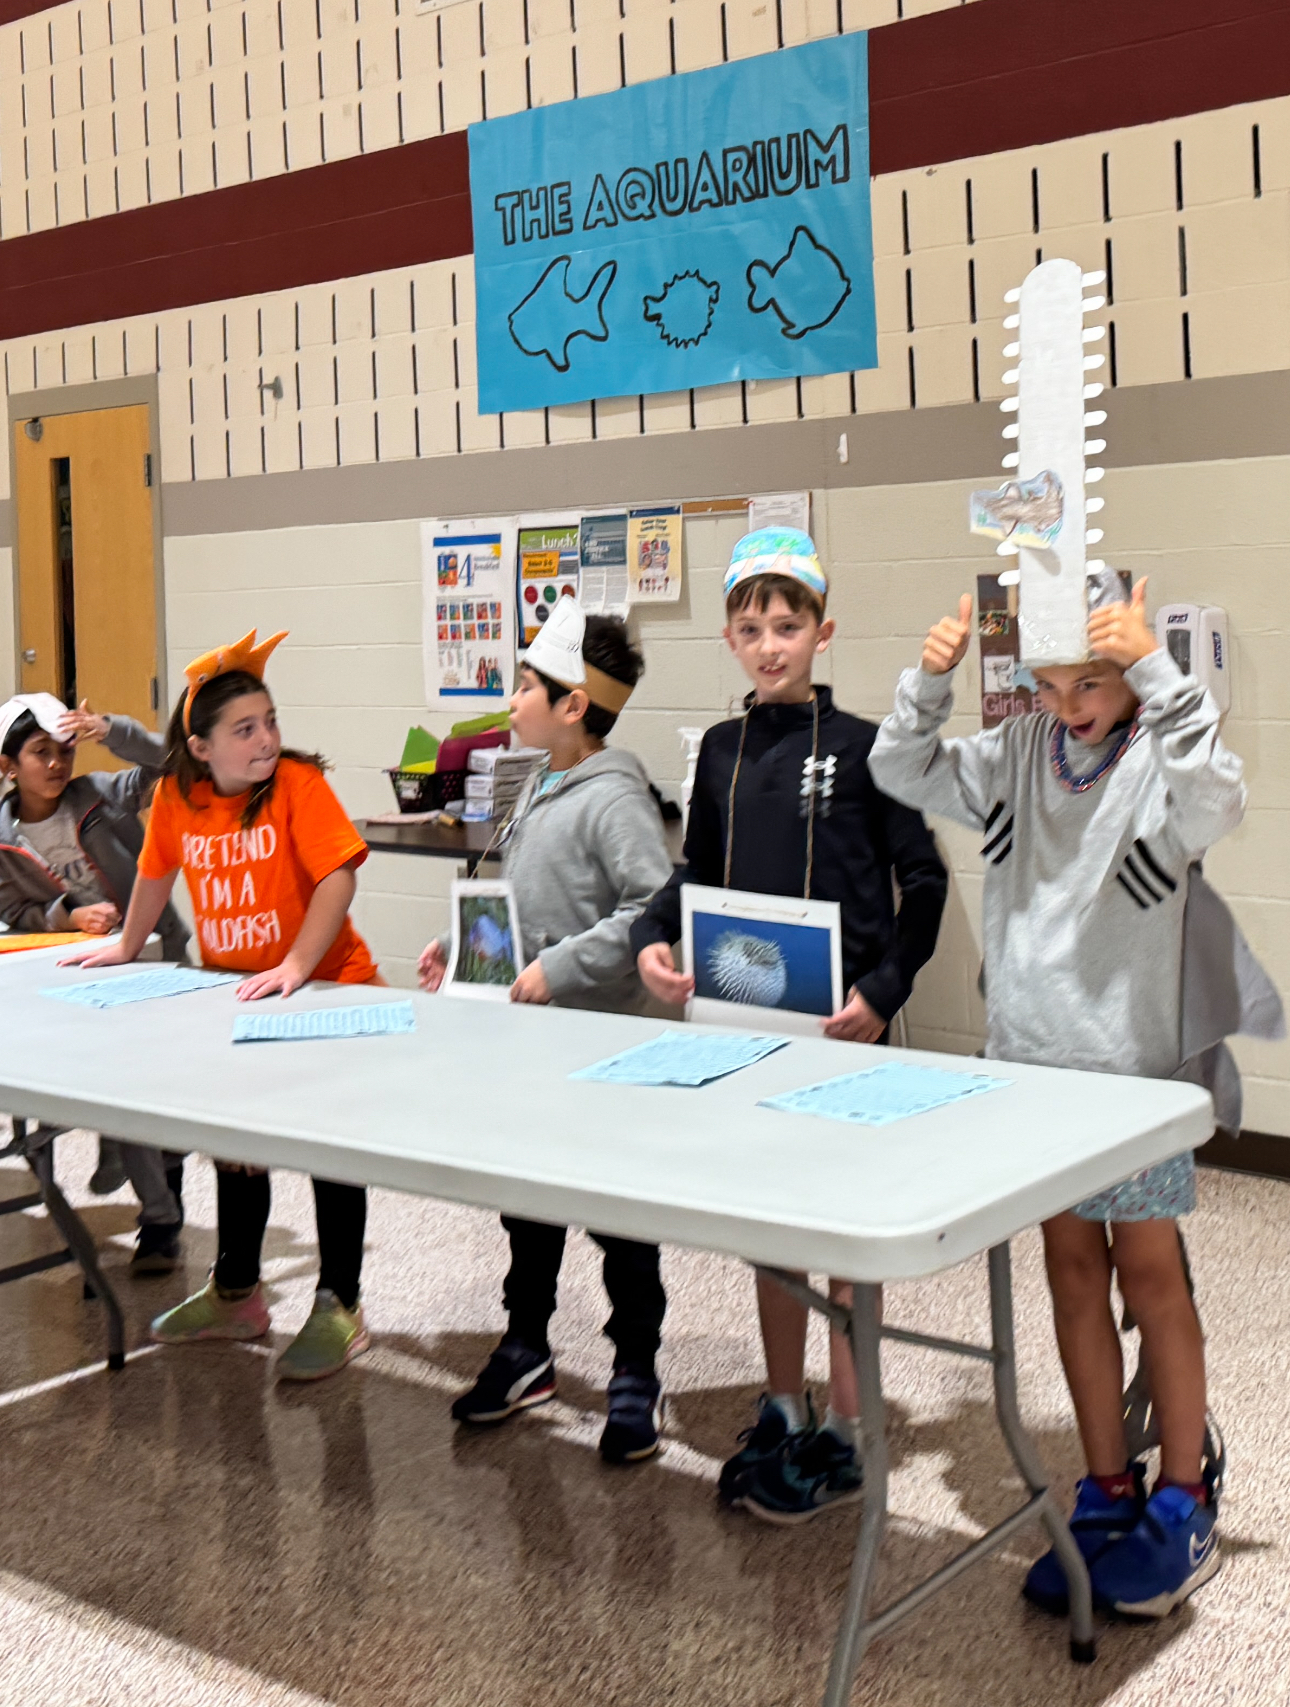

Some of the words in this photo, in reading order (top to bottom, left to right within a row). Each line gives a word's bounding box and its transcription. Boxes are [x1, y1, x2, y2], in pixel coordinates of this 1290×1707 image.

[495, 180, 573, 246] THE
[583, 123, 850, 231] AQUARIUM
[983, 693, 1027, 717] Girls
[181, 823, 277, 870] PRETEND
[200, 871, 233, 911] I'M
[239, 870, 256, 907] A
